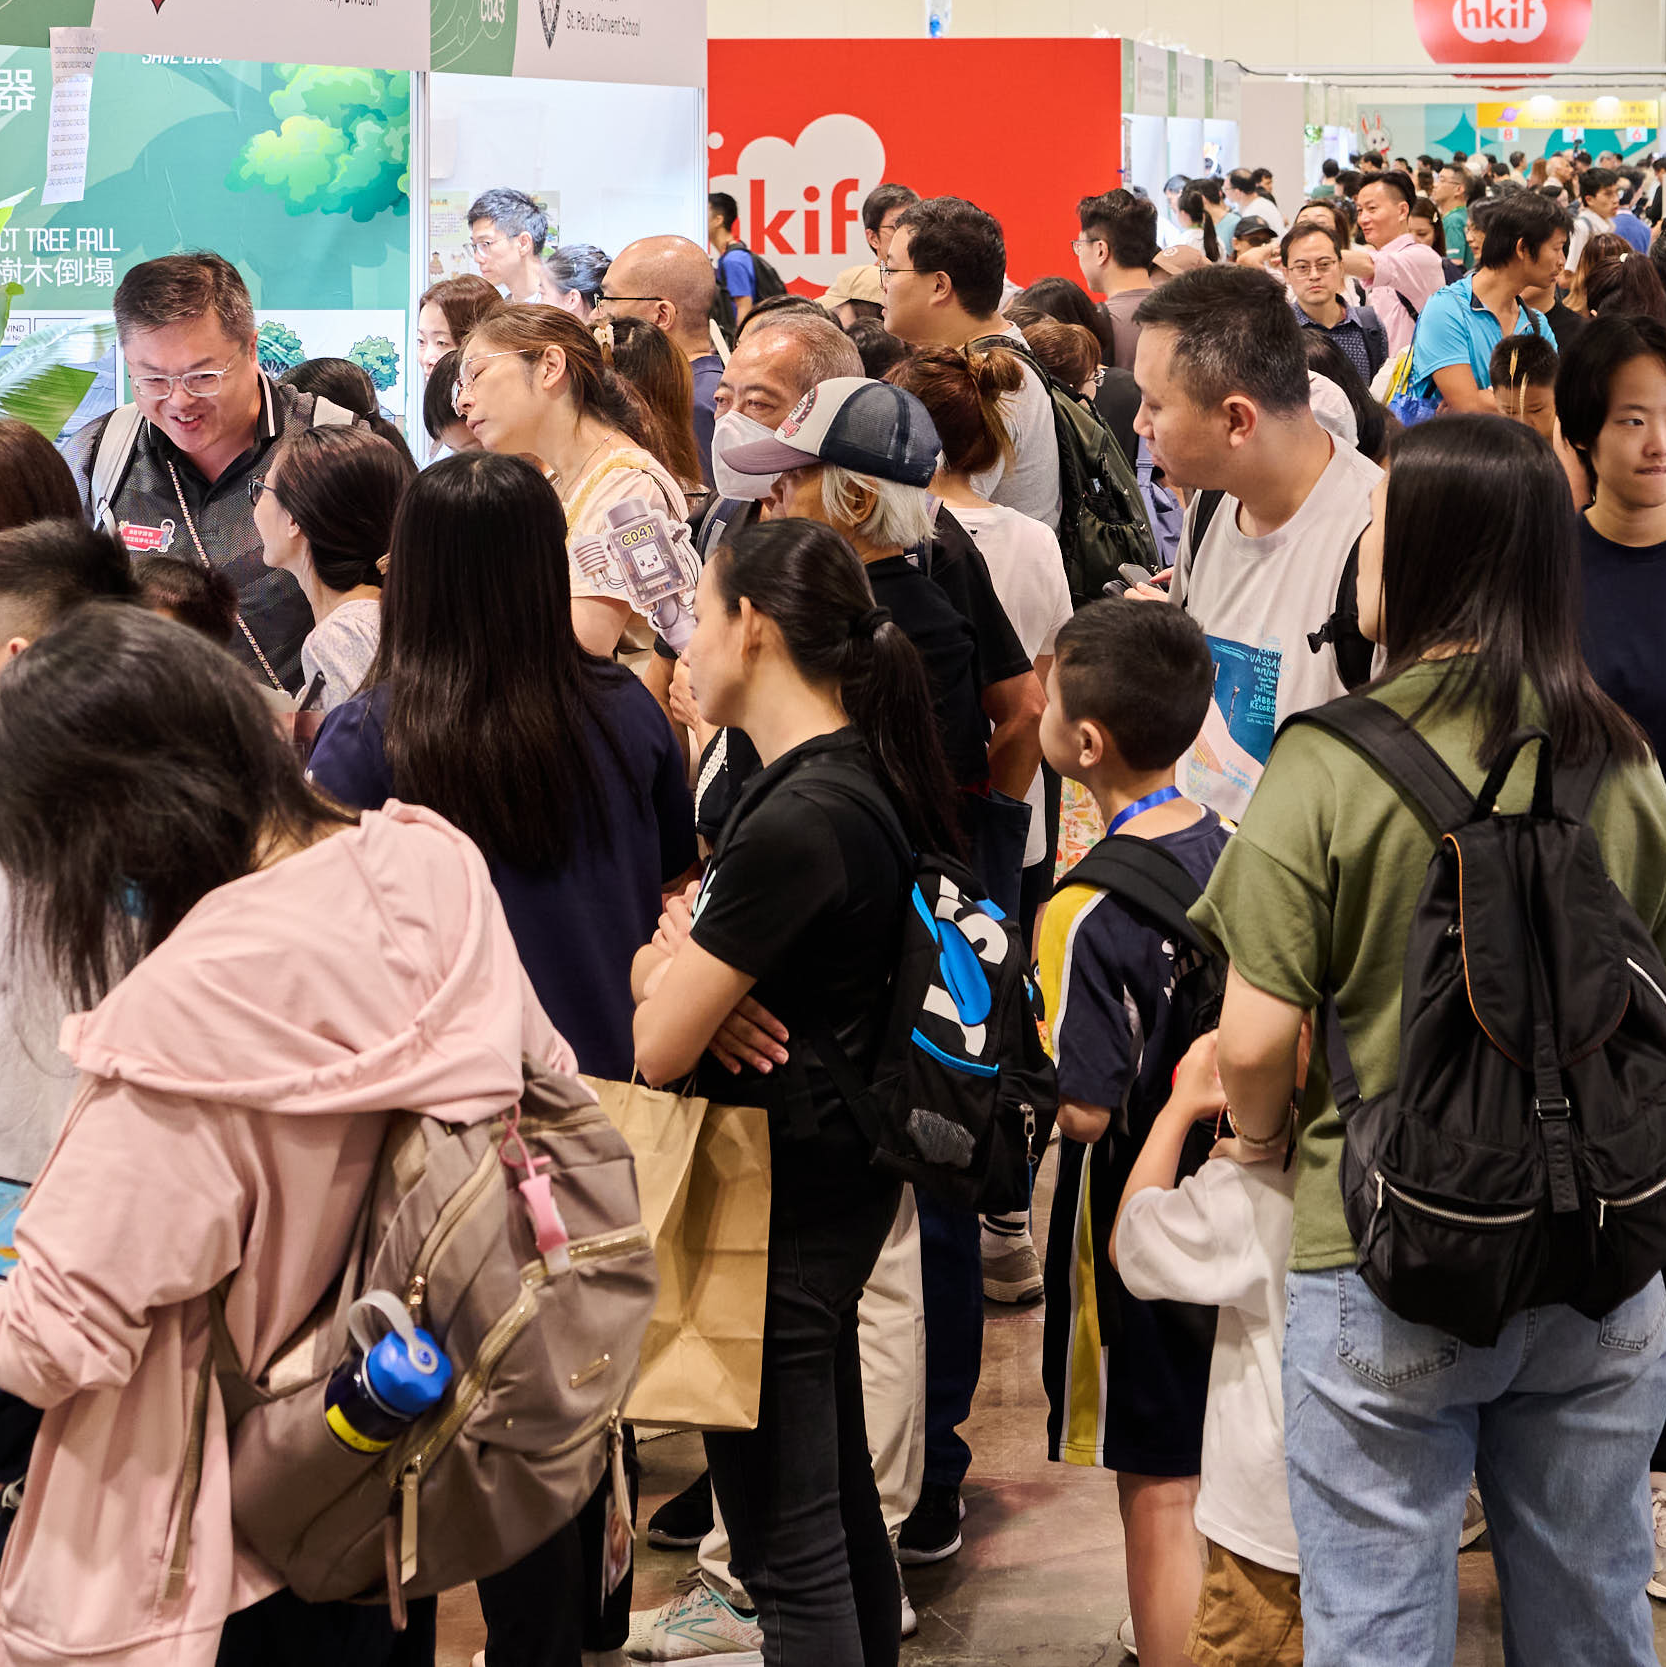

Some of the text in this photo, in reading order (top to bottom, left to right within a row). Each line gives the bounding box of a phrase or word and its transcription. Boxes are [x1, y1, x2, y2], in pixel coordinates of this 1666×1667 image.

[733, 178, 858, 254] kif
[26, 227, 71, 252] TREE
[76, 227, 121, 252] FALL
[618, 523, 658, 549] C041
